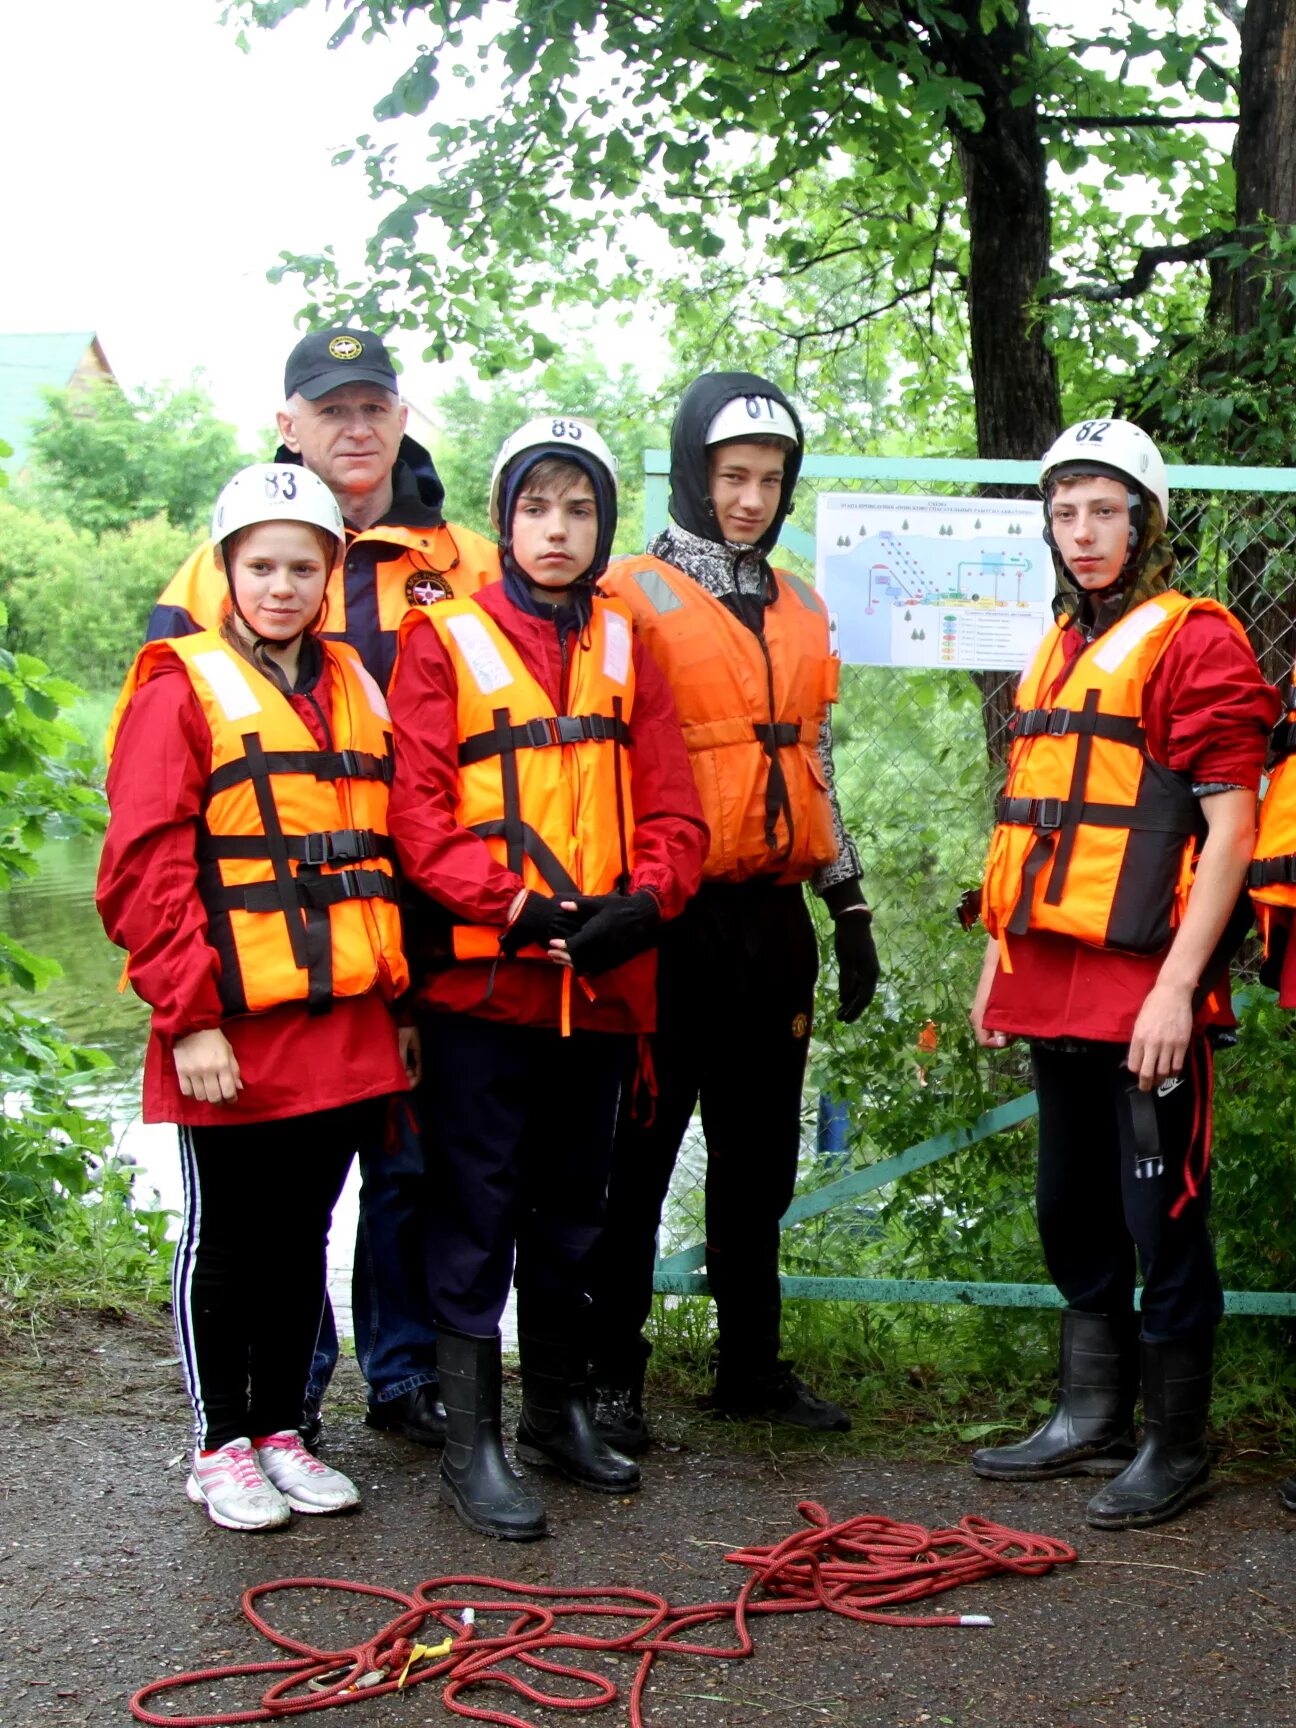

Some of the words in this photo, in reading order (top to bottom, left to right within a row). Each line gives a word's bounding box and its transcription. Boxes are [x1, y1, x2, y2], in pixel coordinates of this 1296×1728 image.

[552, 419, 582, 441] 85
[1076, 421, 1111, 442] 82
[265, 471, 297, 500] 83
